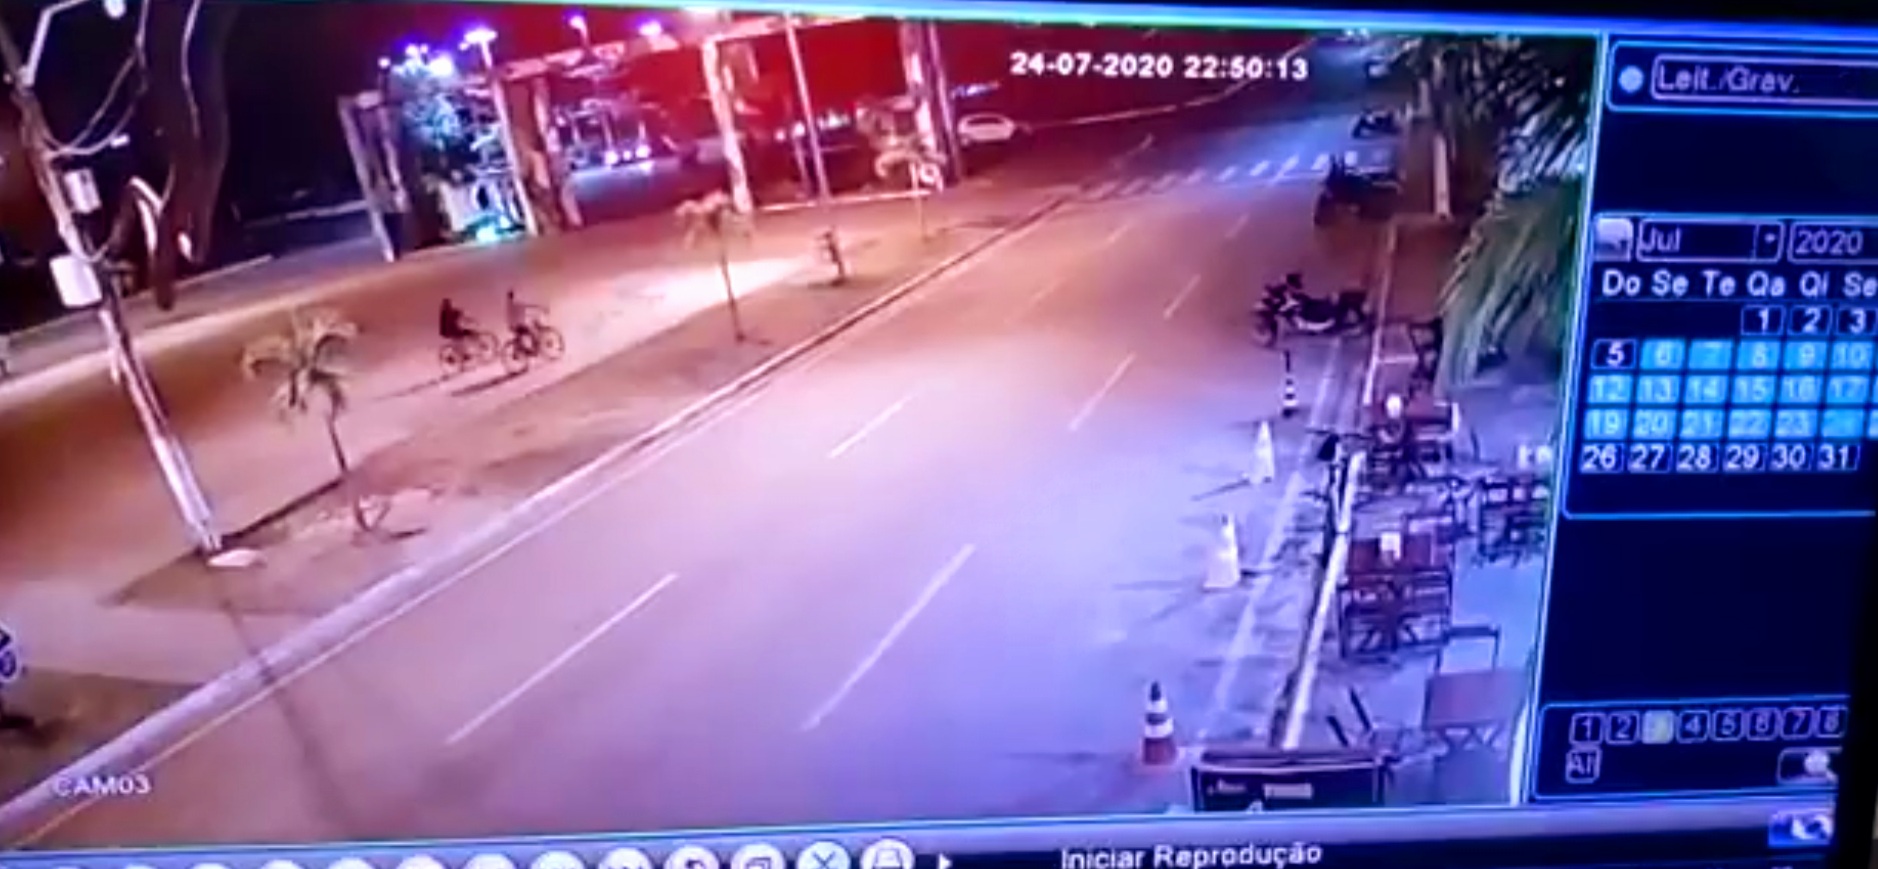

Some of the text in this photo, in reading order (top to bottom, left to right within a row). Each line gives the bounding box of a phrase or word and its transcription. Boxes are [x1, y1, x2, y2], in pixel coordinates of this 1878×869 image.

[1010, 52, 1309, 80] 24-07-2020 22:50:13
[1643, 226, 1681, 252] Jul
[1793, 229, 1864, 256] 2020
[1602, 268, 1642, 297] Do
[1651, 269, 1690, 297] Se
[1702, 269, 1737, 297] Te
[1746, 270, 1786, 297] Qa
[1843, 271, 1878, 297] Se
[1757, 307, 1867, 333] 1 2 3
[1606, 341, 1625, 371] 5
[1757, 343, 1774, 370] 8
[1800, 344, 1816, 370] 9
[1837, 345, 1868, 371] 10
[1594, 375, 1863, 401] 12 13 14 15 16 17
[1590, 411, 1621, 435] 19
[1634, 411, 1670, 437] 20
[1681, 411, 1715, 436] 21
[1728, 411, 1766, 437] 22
[1584, 445, 1850, 472] 26 27 28 29 30 31
[1581, 715, 1594, 739] 1
[1615, 716, 1635, 739] 2
[1685, 713, 1703, 735] 4
[1792, 709, 1809, 732] 7
[55, 775, 151, 796] CAM03
[1061, 841, 1323, 869] Iniciar Reprodução
